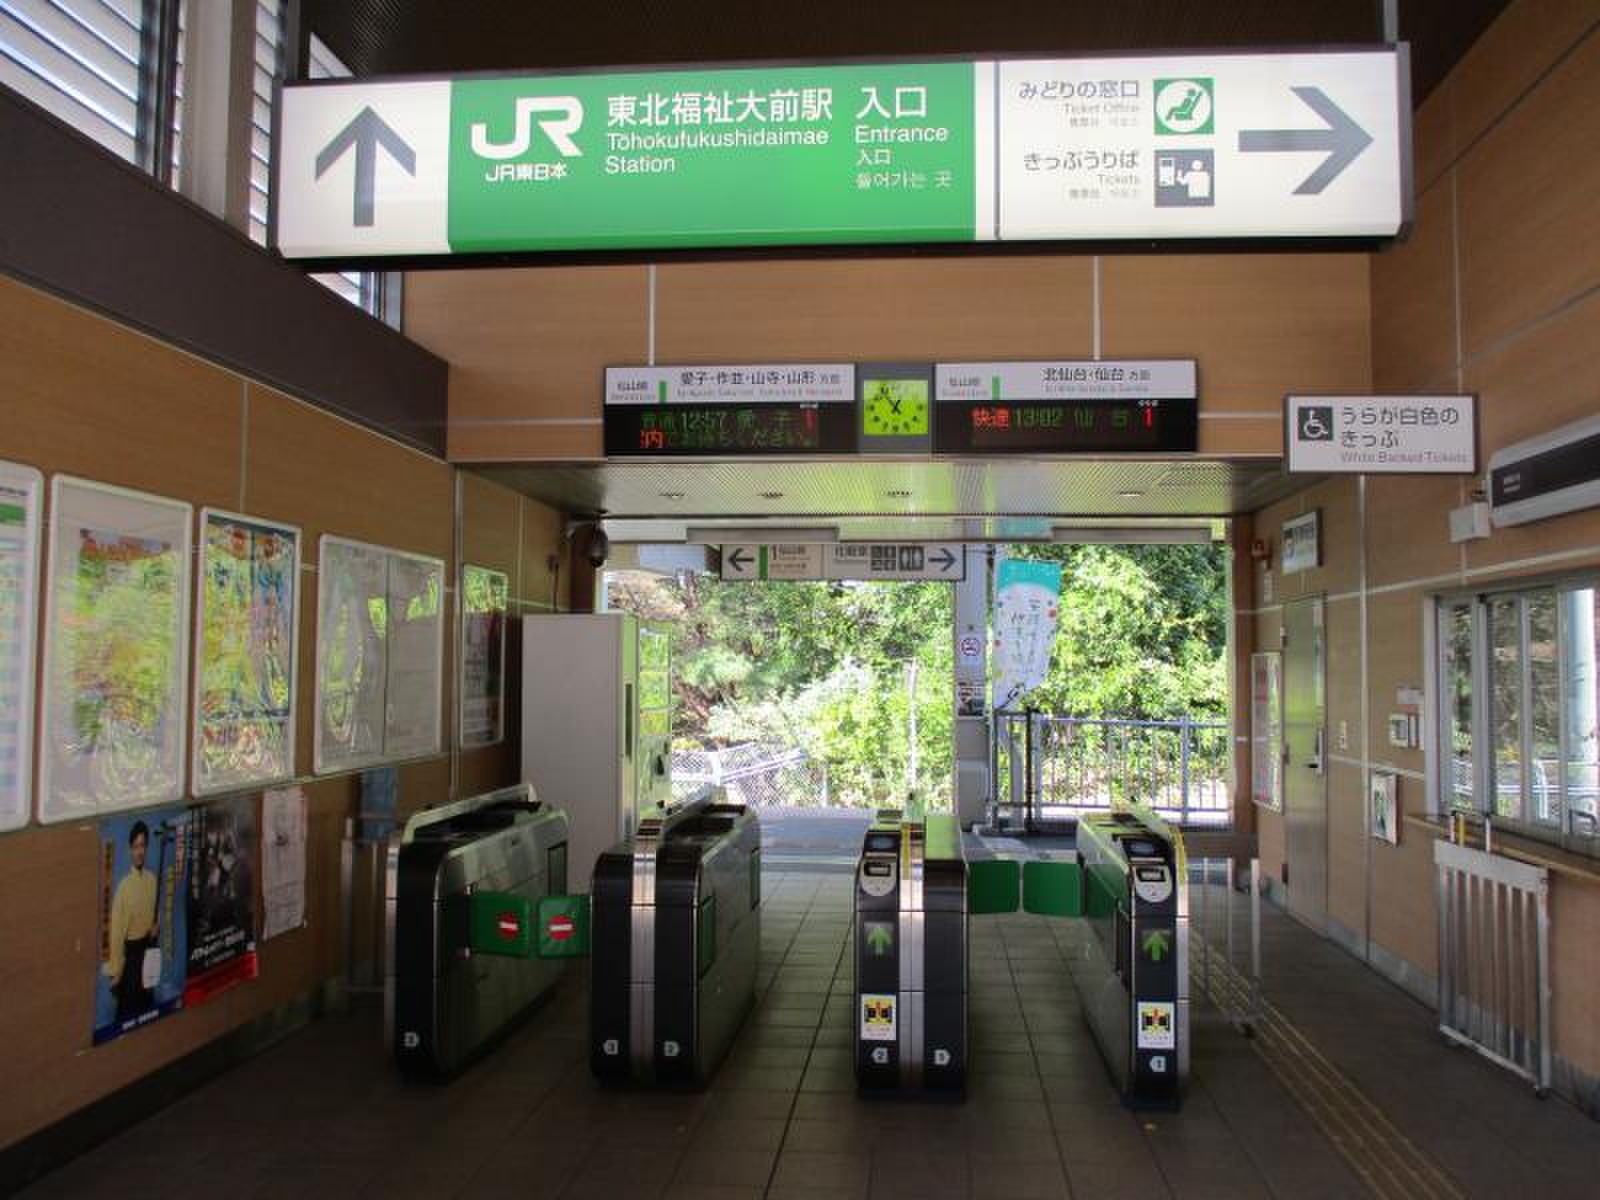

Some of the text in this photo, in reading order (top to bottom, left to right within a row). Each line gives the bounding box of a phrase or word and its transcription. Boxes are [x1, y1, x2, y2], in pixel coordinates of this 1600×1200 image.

[1019, 80, 1139, 100] みどりの窓口
[606, 86, 834, 128] 東北福祉大前駅
[856, 86, 927, 119] 入口
[470, 95, 584, 160] JR
[855, 125, 949, 144] Entrance
[605, 155, 676, 175] Station
[856, 148, 892, 166] 入口
[1023, 150, 1139, 172] きっぷうりば
[485, 161, 567, 182] JR東日本
[1342, 405, 1460, 427] うらが白色の
[1341, 430, 1401, 449] きっぷ
